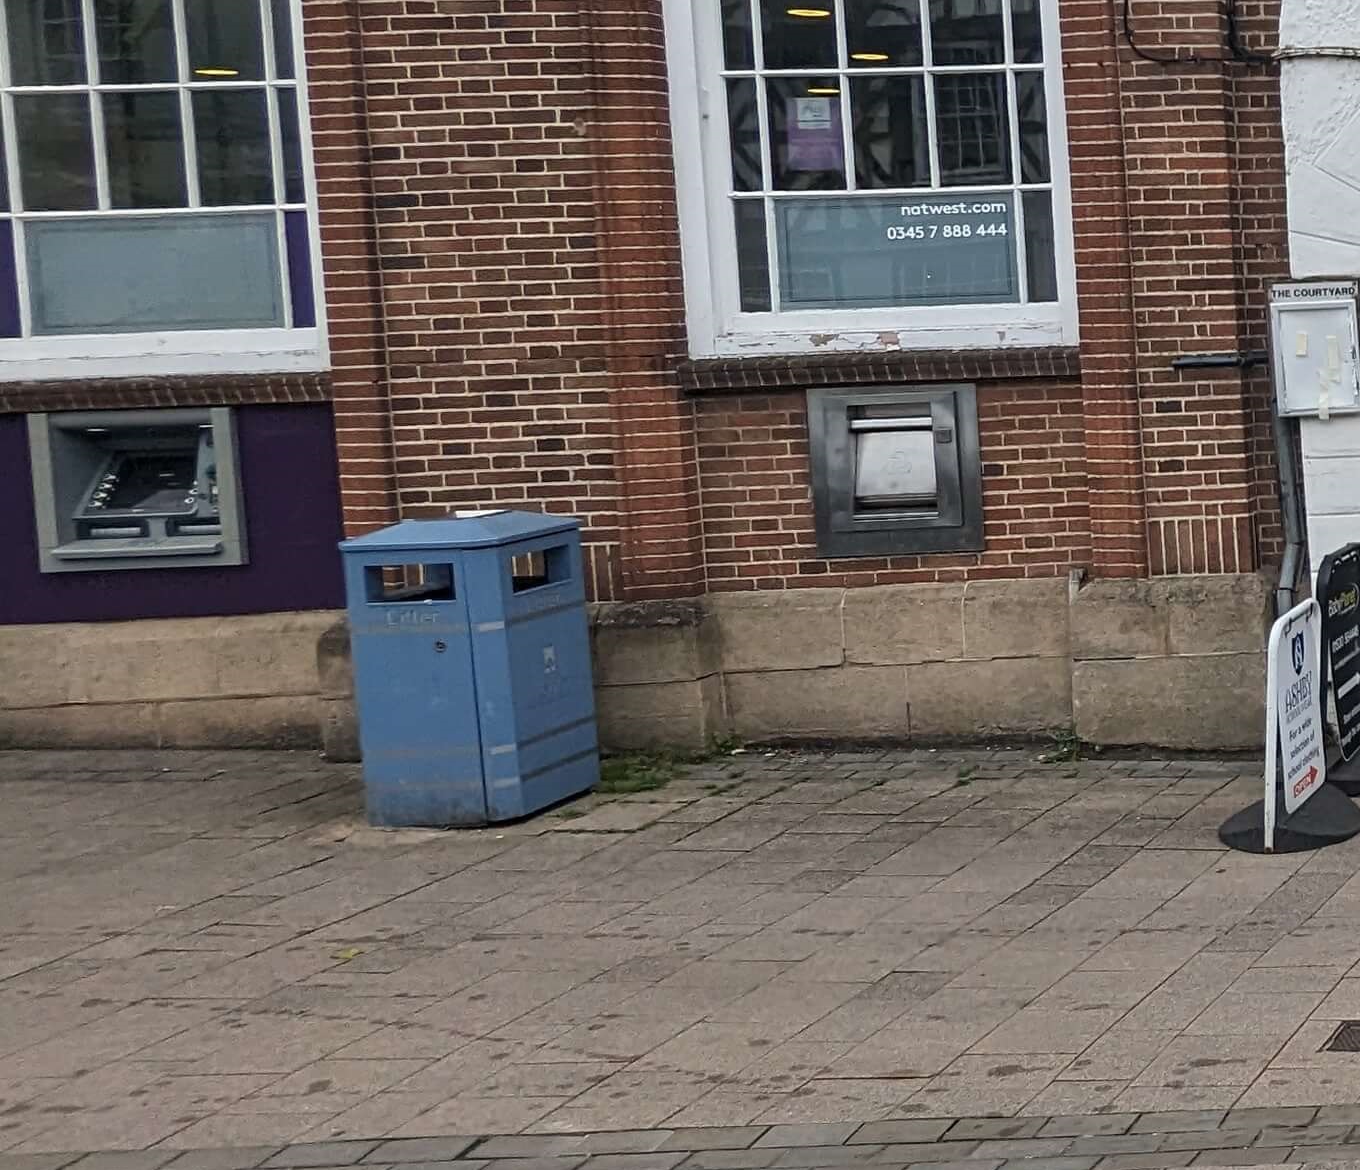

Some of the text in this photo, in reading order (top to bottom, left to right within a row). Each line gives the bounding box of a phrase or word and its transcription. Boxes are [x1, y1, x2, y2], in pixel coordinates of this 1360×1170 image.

[901, 202, 1006, 216] natwest.com
[887, 223, 1008, 240] 0345 7 888 444
[1272, 287, 1355, 298] THE COURTYARD
[1285, 671, 1312, 713] ASHBY
[1289, 727, 1299, 741] For
